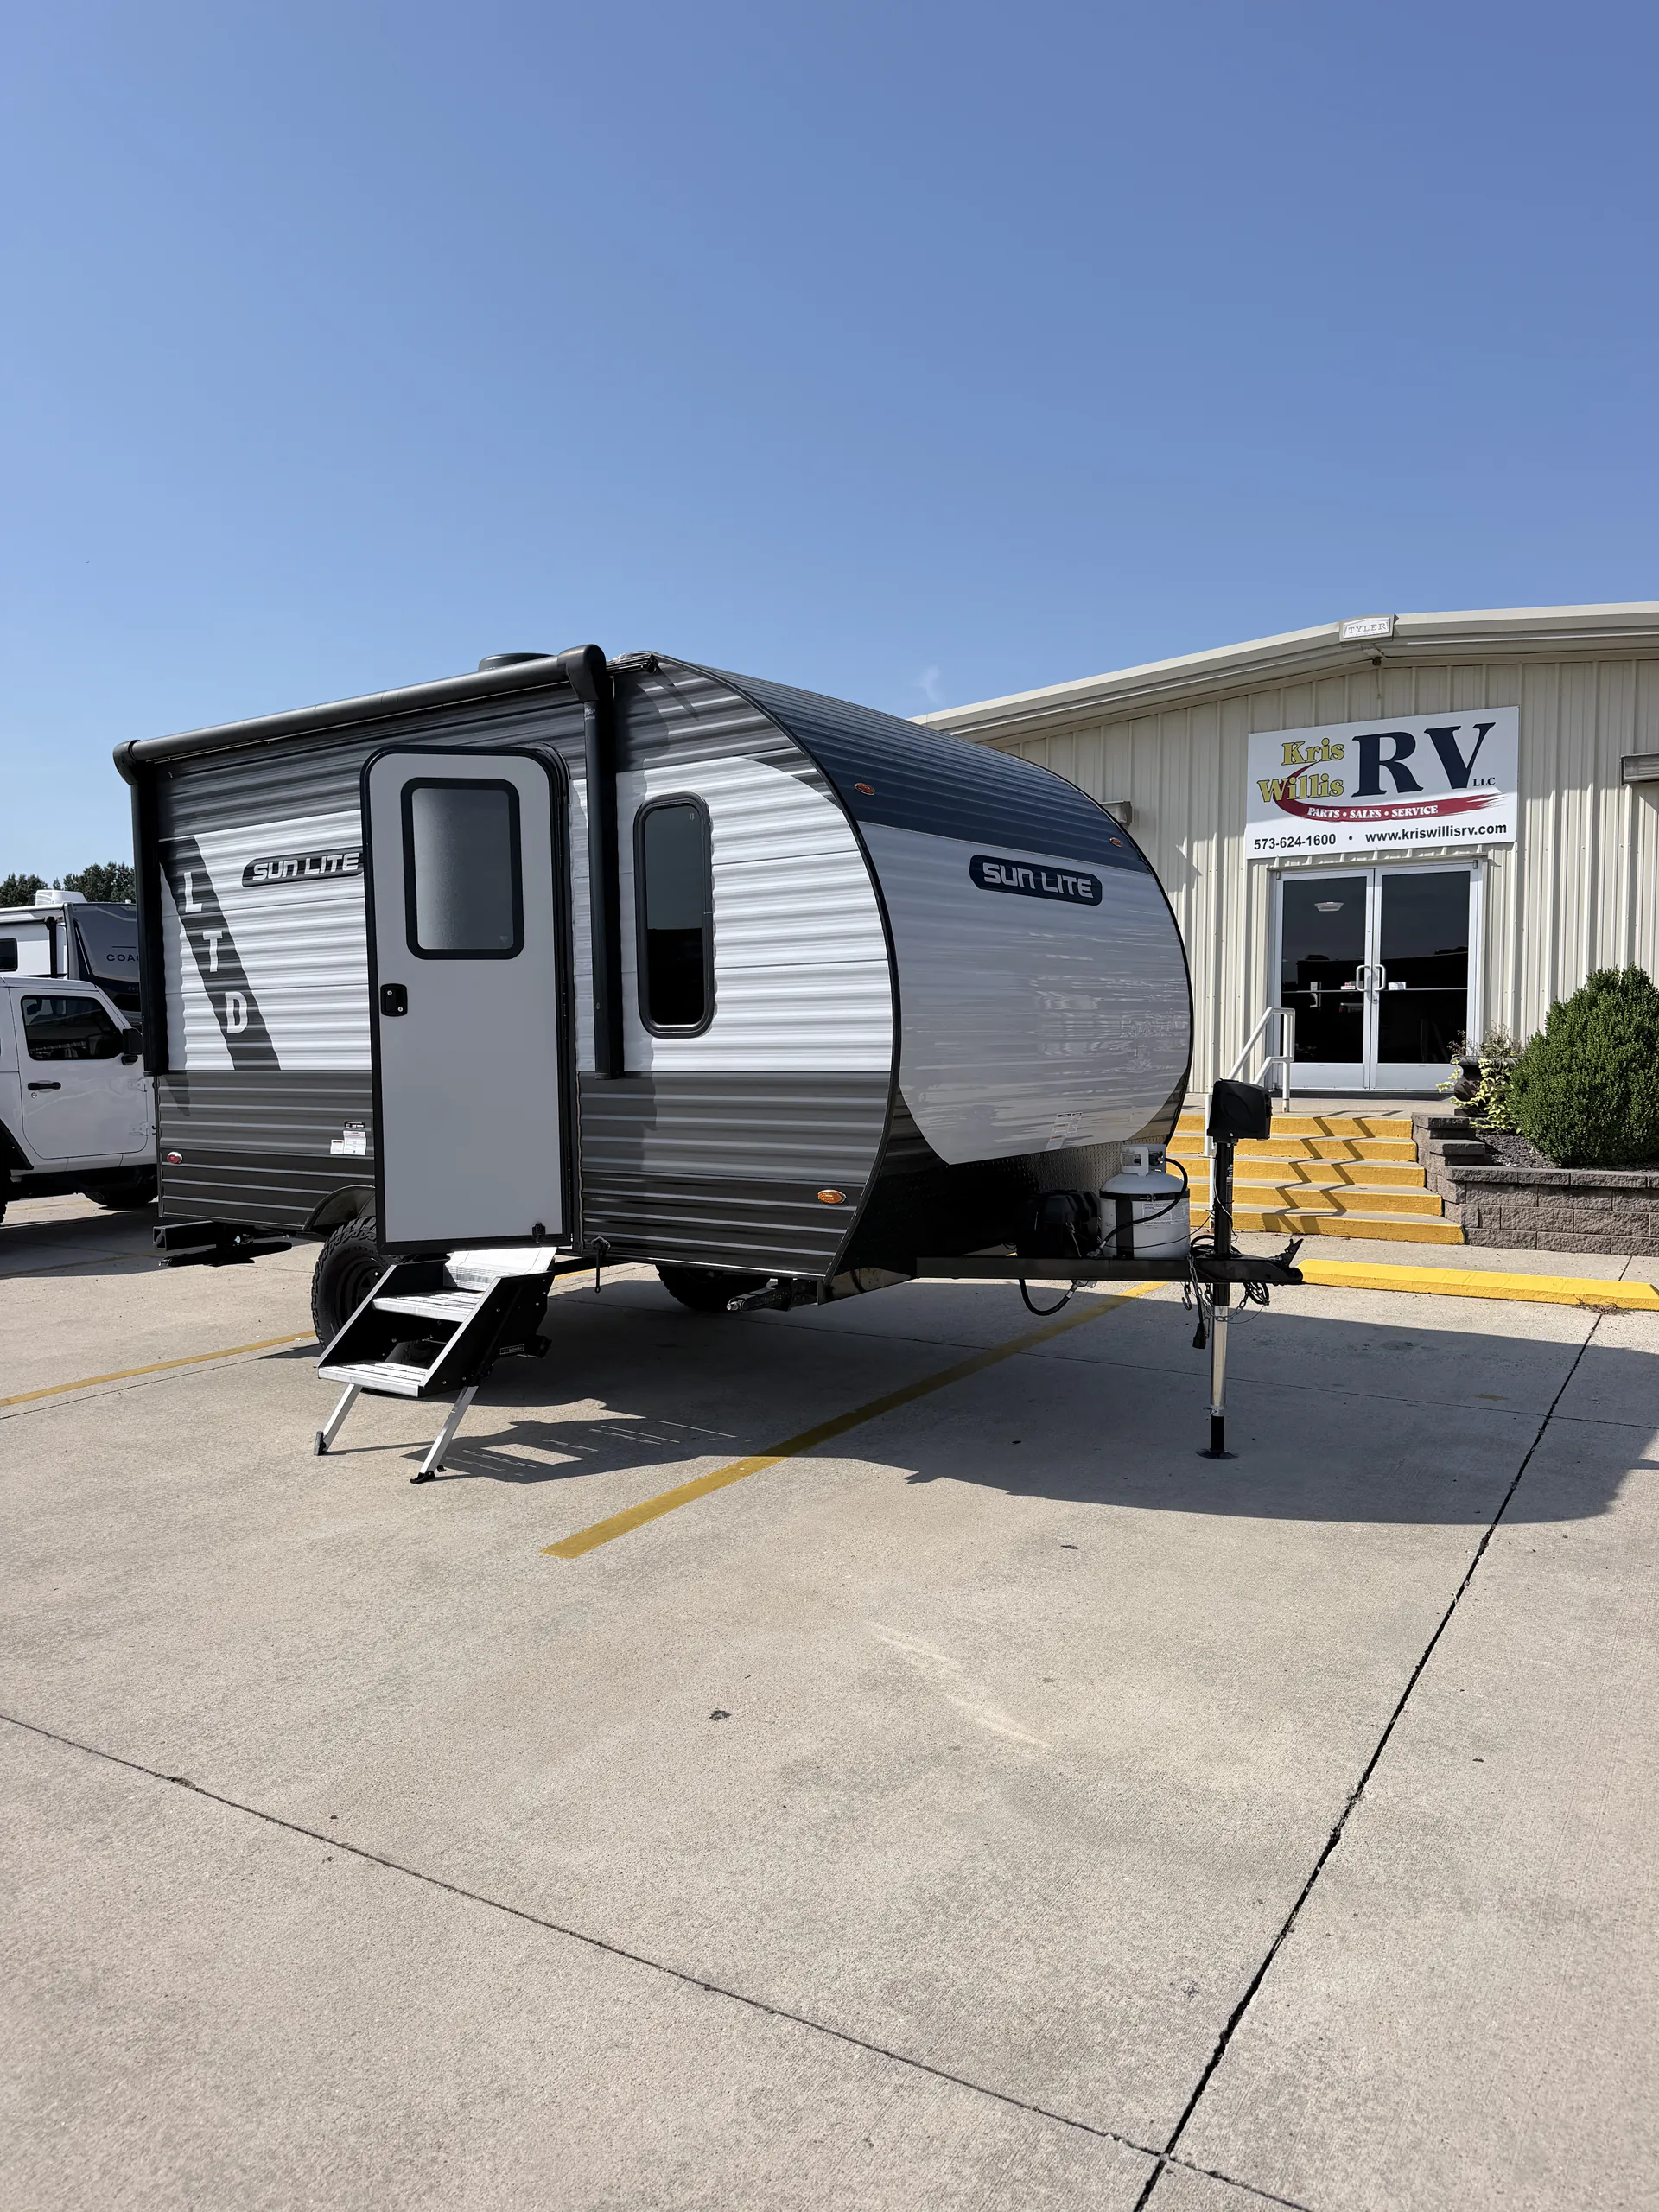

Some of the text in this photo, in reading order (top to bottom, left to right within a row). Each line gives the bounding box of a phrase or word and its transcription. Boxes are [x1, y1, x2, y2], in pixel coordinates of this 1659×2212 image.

[1348, 623, 1387, 634] TYLER
[1281, 737, 1345, 766] Kris
[1351, 721, 1497, 798] RV
[1256, 773, 1344, 803] Willis
[1472, 777, 1496, 787] LLC
[1307, 805, 1439, 819] PARTS SALES SERVICE
[1254, 824, 1507, 850] 573-624-1600 www.kriswillisrv.com
[252, 852, 360, 881] SUN LITE
[982, 862, 1094, 899] SUN LITE
[183, 871, 248, 1033] LTD
